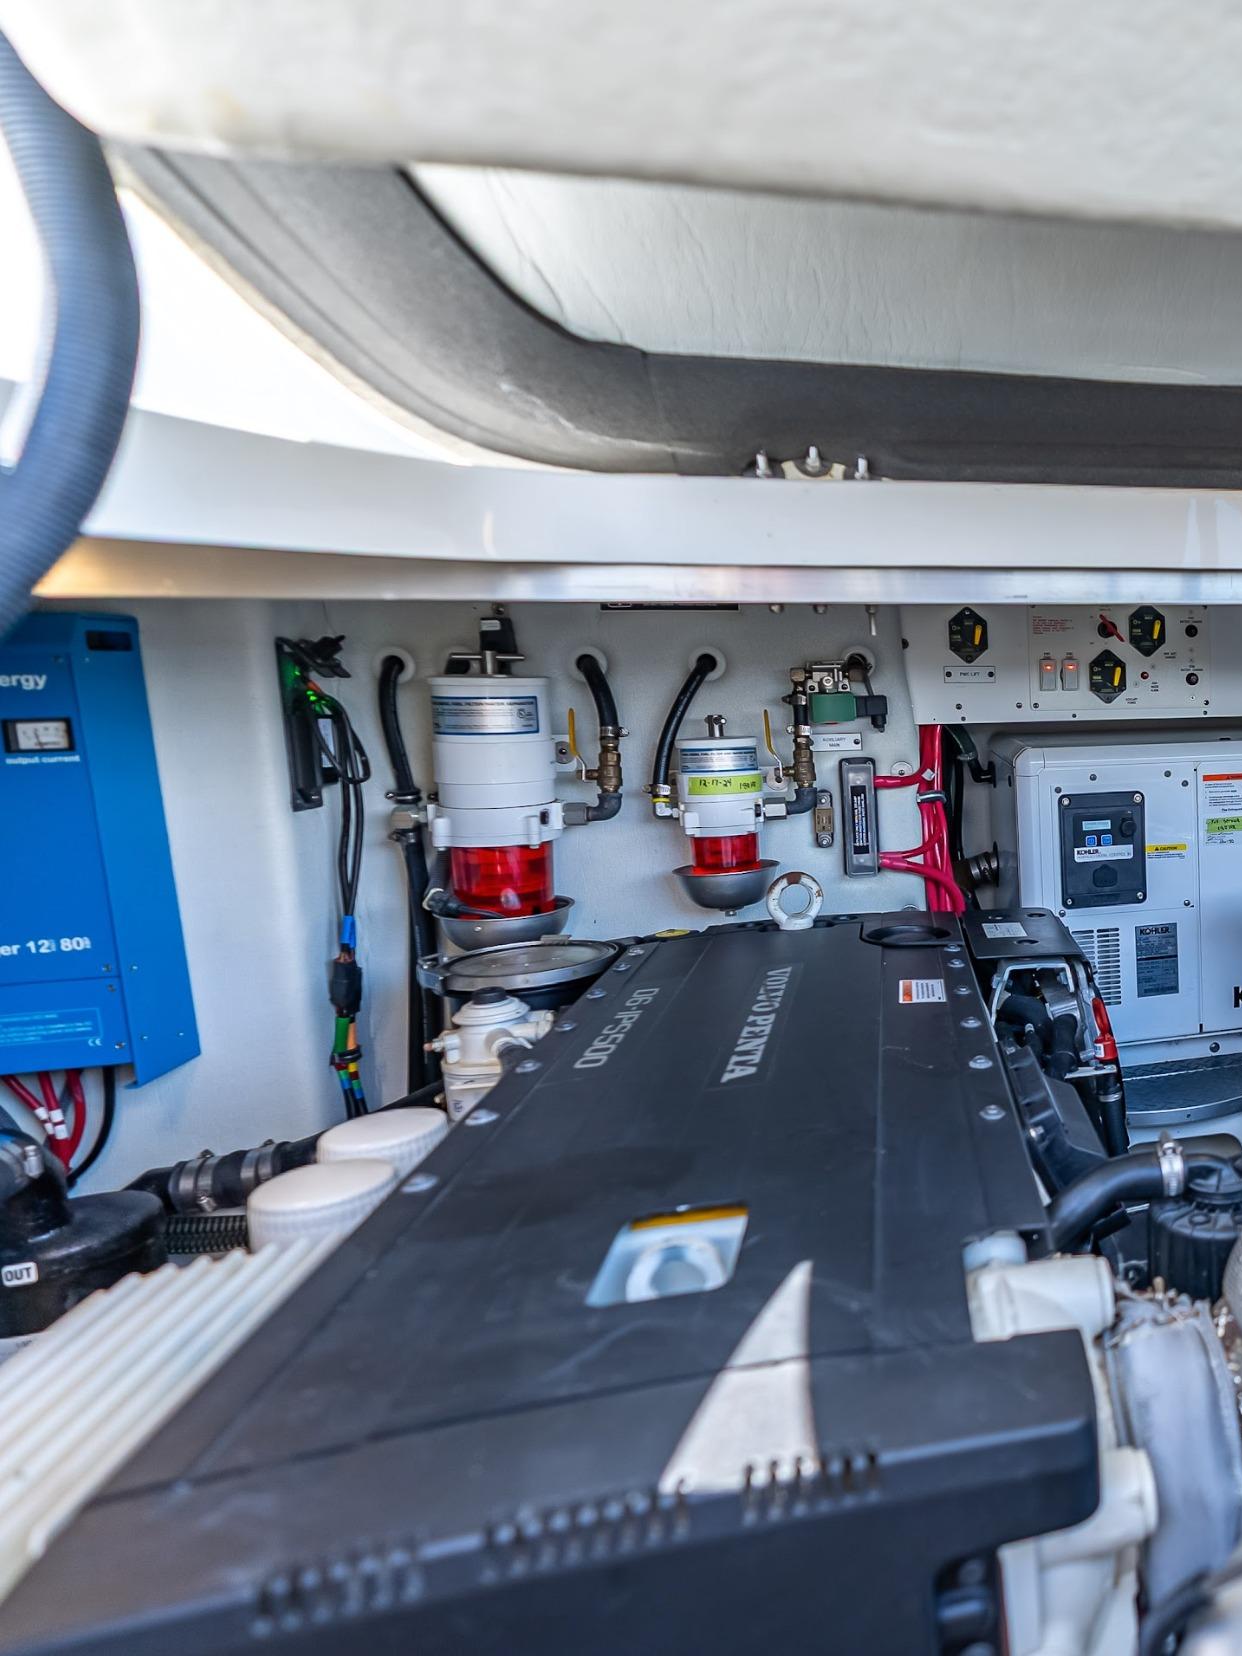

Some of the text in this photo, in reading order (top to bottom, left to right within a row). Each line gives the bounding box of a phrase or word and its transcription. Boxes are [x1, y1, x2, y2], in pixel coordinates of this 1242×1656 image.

[1140, 926, 1169, 936] KOHLER
[720, 966, 793, 1084] VOLVO PENTA
[4, 1266, 32, 1282] OUT
